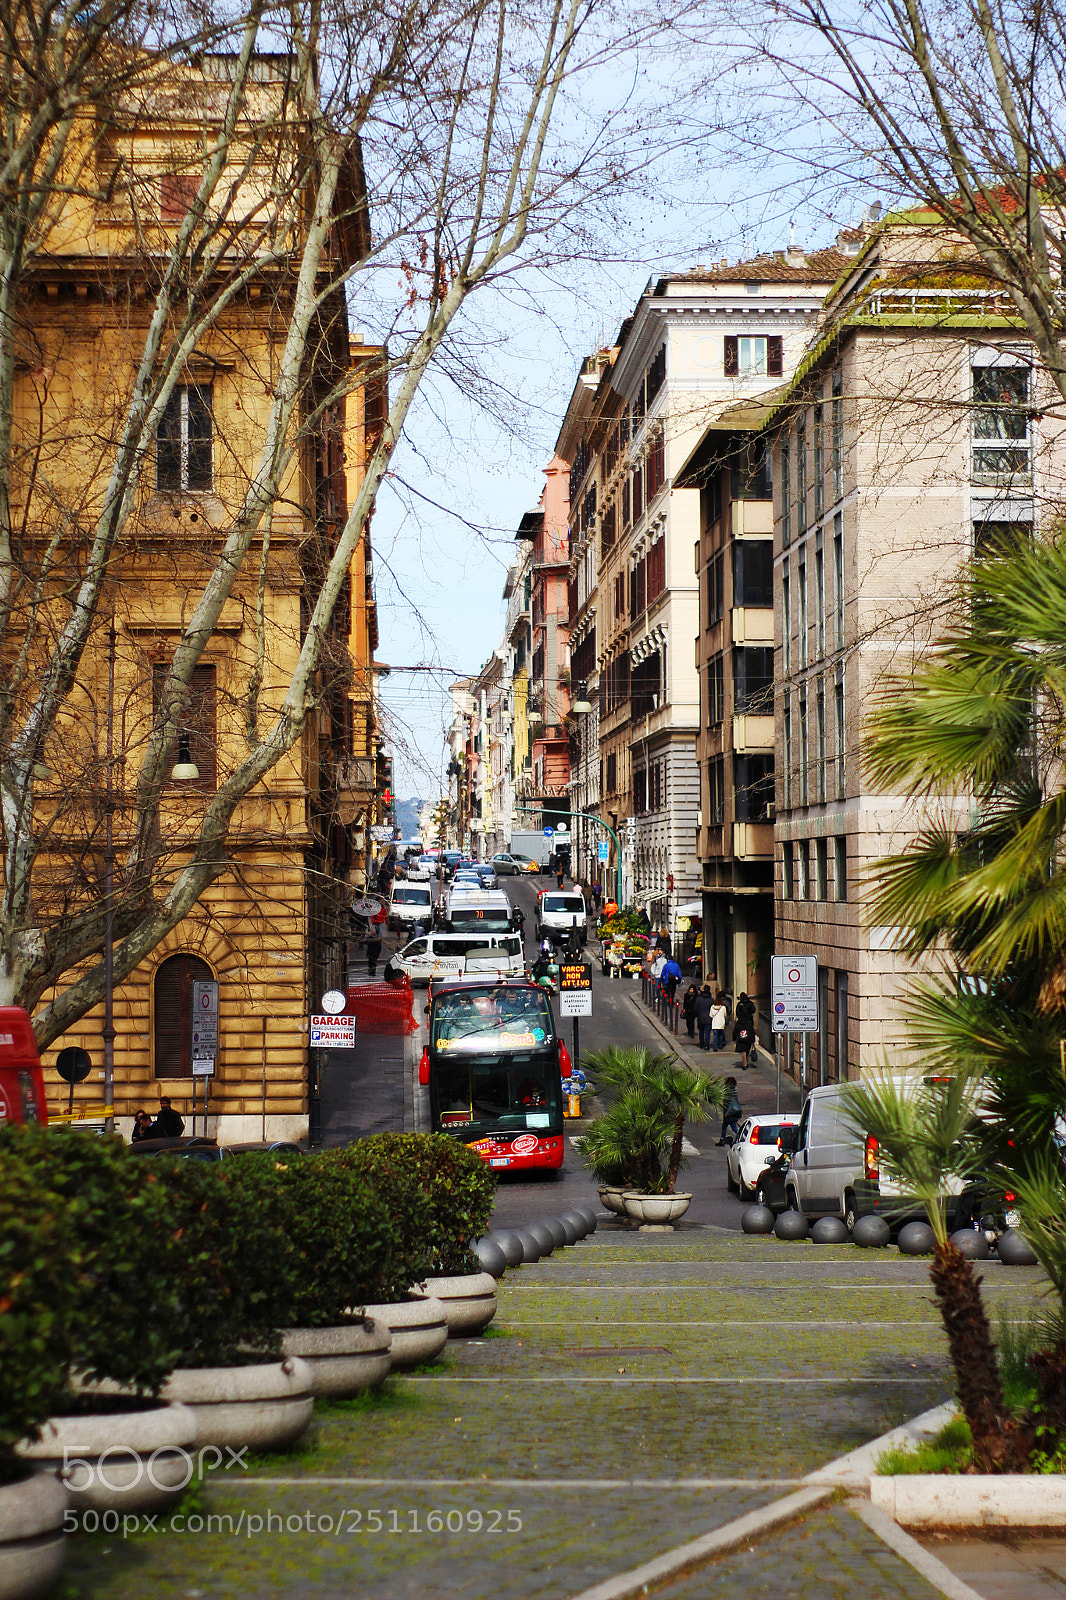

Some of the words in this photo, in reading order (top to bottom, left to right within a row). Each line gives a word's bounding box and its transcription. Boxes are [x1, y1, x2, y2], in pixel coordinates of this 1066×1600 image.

[626, 817, 636, 862] HOTEL
[475, 910, 484, 919] 70
[561, 965, 585, 973] VARCO
[561, 979, 590, 987] ATTIVO
[312, 1016, 354, 1026] GARAGE
[321, 1032, 354, 1040] PARKING
[501, 1032, 535, 1047] Roma
